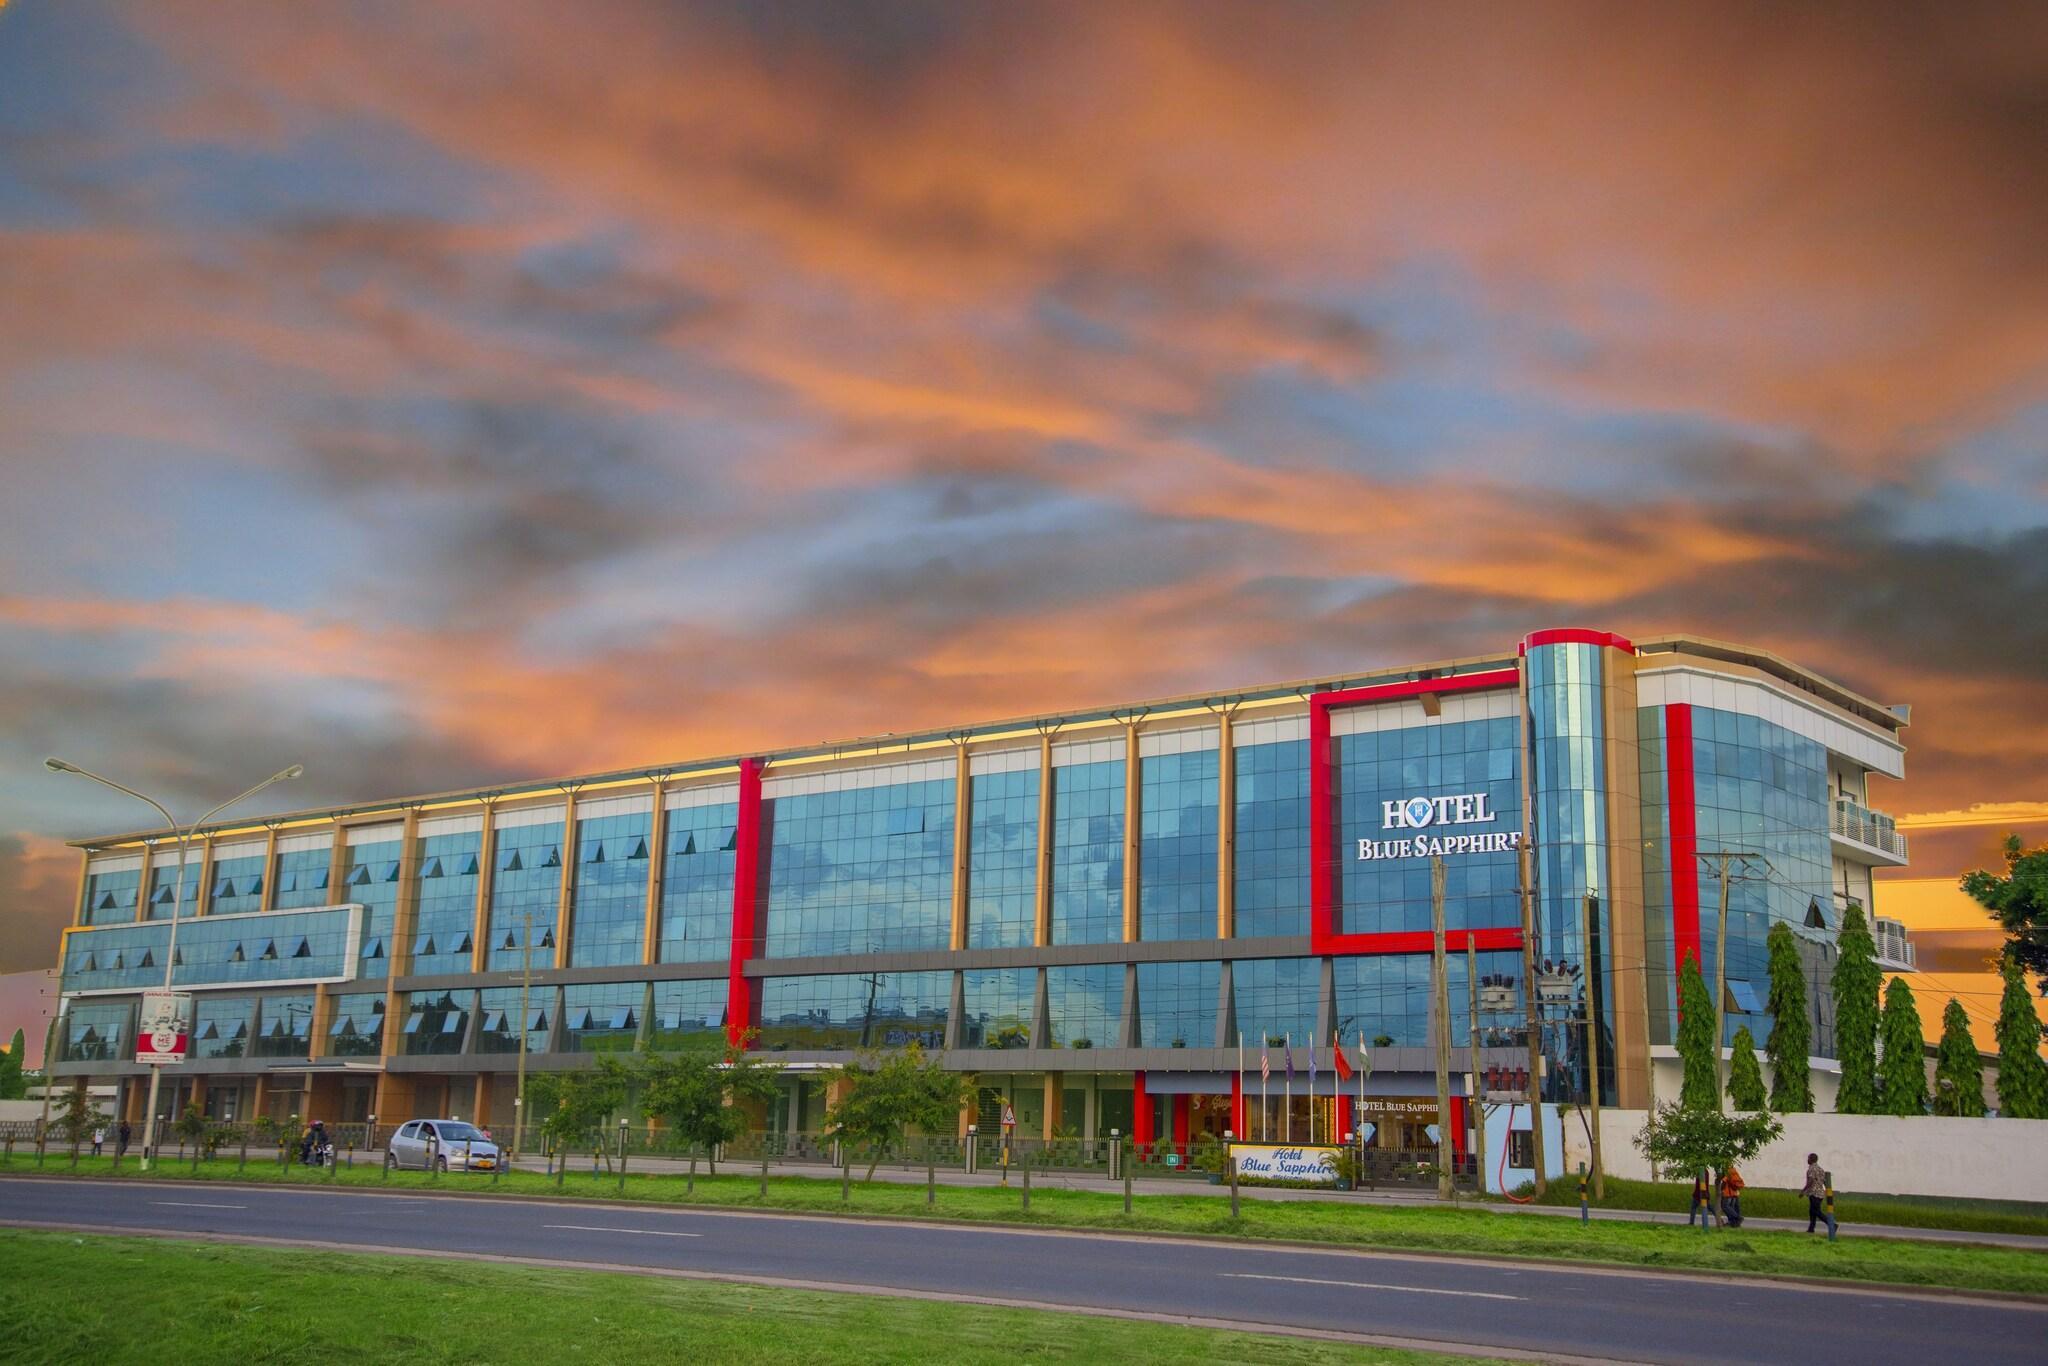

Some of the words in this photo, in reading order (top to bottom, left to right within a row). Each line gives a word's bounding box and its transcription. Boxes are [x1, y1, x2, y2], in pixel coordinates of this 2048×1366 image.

[1382, 793, 1495, 829] HOTEL
[1358, 838, 1412, 860] BLUE
[1415, 831, 1522, 857] SAPPHIRE
[1354, 1101, 1385, 1111] HOTEL
[1386, 1102, 1406, 1111] BLUE
[1407, 1103, 1439, 1112] SAPPHI
[1272, 1148, 1303, 1160] Hotel
[1240, 1157, 1271, 1171] Blue
[1276, 1160, 1334, 1175] Sapphire
